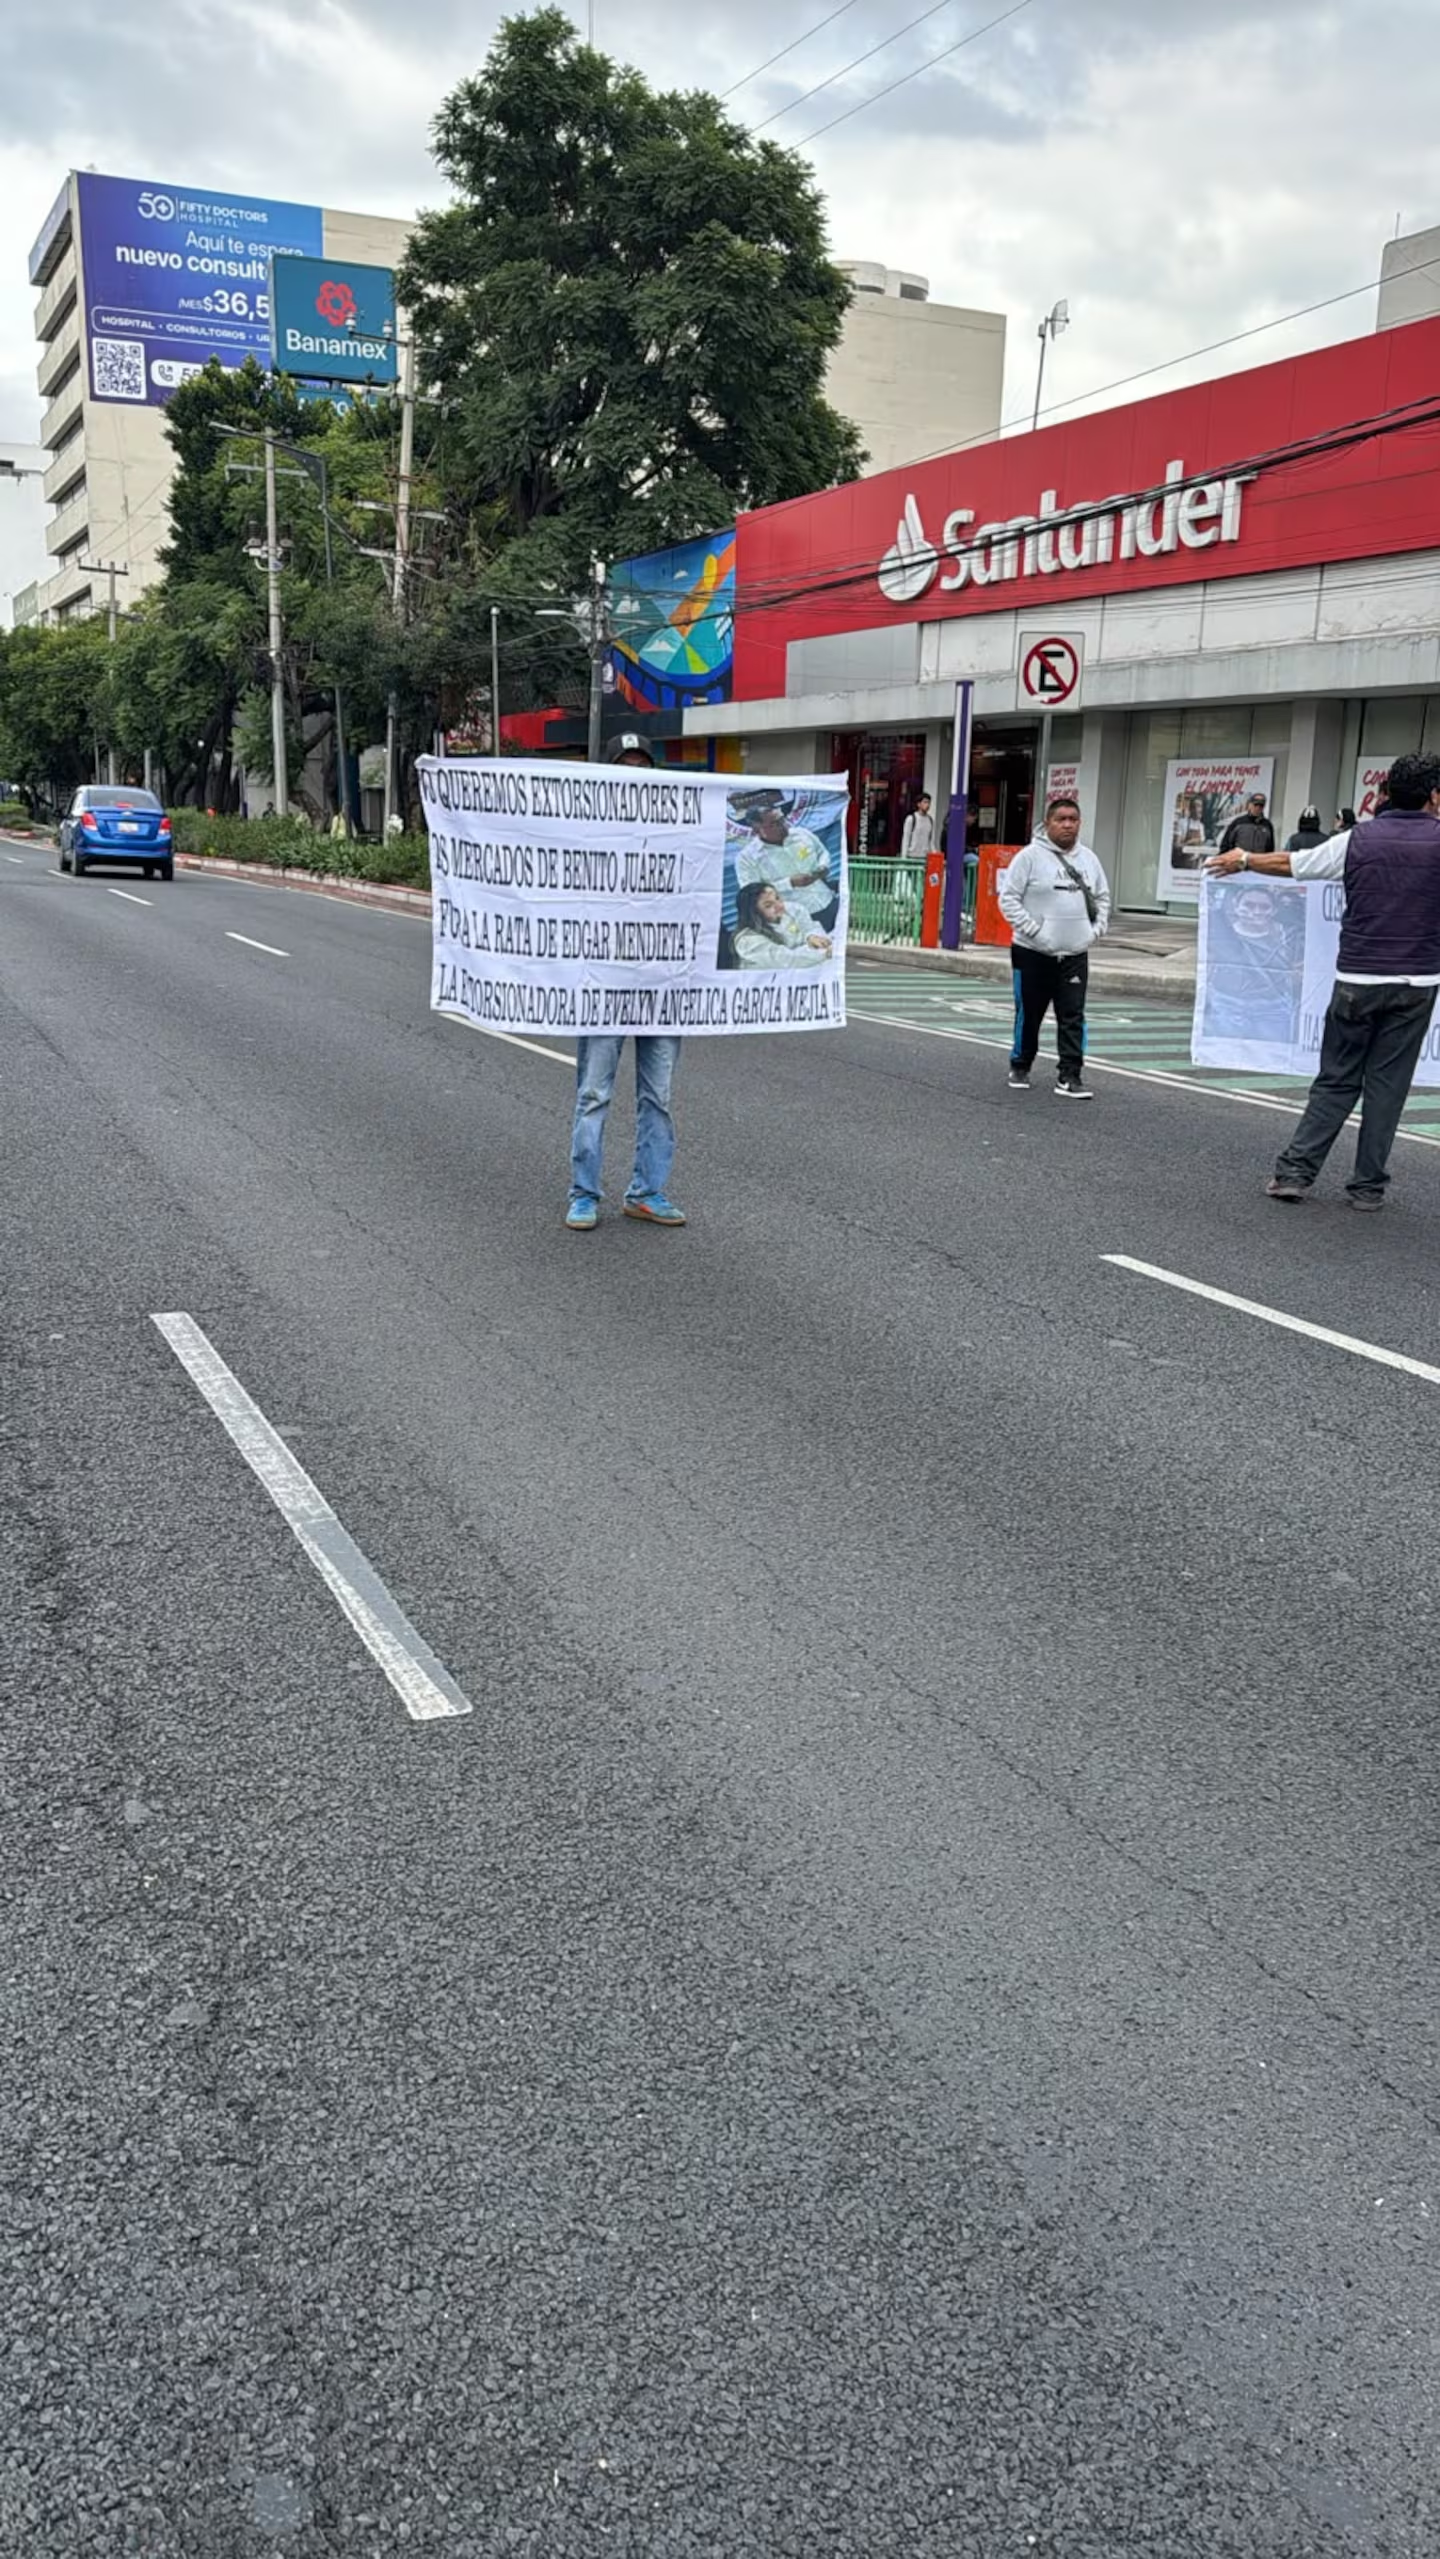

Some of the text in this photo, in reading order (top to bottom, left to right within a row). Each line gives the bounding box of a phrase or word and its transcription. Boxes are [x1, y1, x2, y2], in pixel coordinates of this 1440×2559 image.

[180, 201, 211, 213] FIFTY
[213, 206, 268, 223] DOCTORS
[180, 212, 239, 228] HOSPITAL
[116, 245, 183, 271] nuevo
[185, 230, 225, 252] Aquí
[227, 235, 244, 254] te
[101, 315, 156, 330] HOSPITAL
[165, 322, 246, 341] CONSULTORIOS
[285, 328, 388, 361] Banamex
[940, 459, 1258, 591] Santander
[437, 768, 526, 816] QUEREMOS
[531, 776, 678, 825] EXTORSIONADORES
[682, 786, 704, 824] EN
[451, 837, 534, 888] MERCADOS
[537, 847, 558, 889] DE
[563, 850, 619, 892] BENITO
[621, 838, 676, 893] JUÁREZ
[472, 910, 491, 952] LA
[494, 914, 533, 956] RATA
[537, 918, 557, 959] DE
[562, 919, 610, 960] EDGAR
[614, 921, 687, 962] MENDIETA
[691, 922, 701, 960] Y
[438, 963, 458, 1001] LA
[580, 988, 600, 1026] DE
[603, 988, 659, 1026] EVELYN
[658, 988, 727, 1026] ANGELICA
[732, 973, 782, 1024] GARCÍA
[785, 984, 829, 1022] MEJIA
